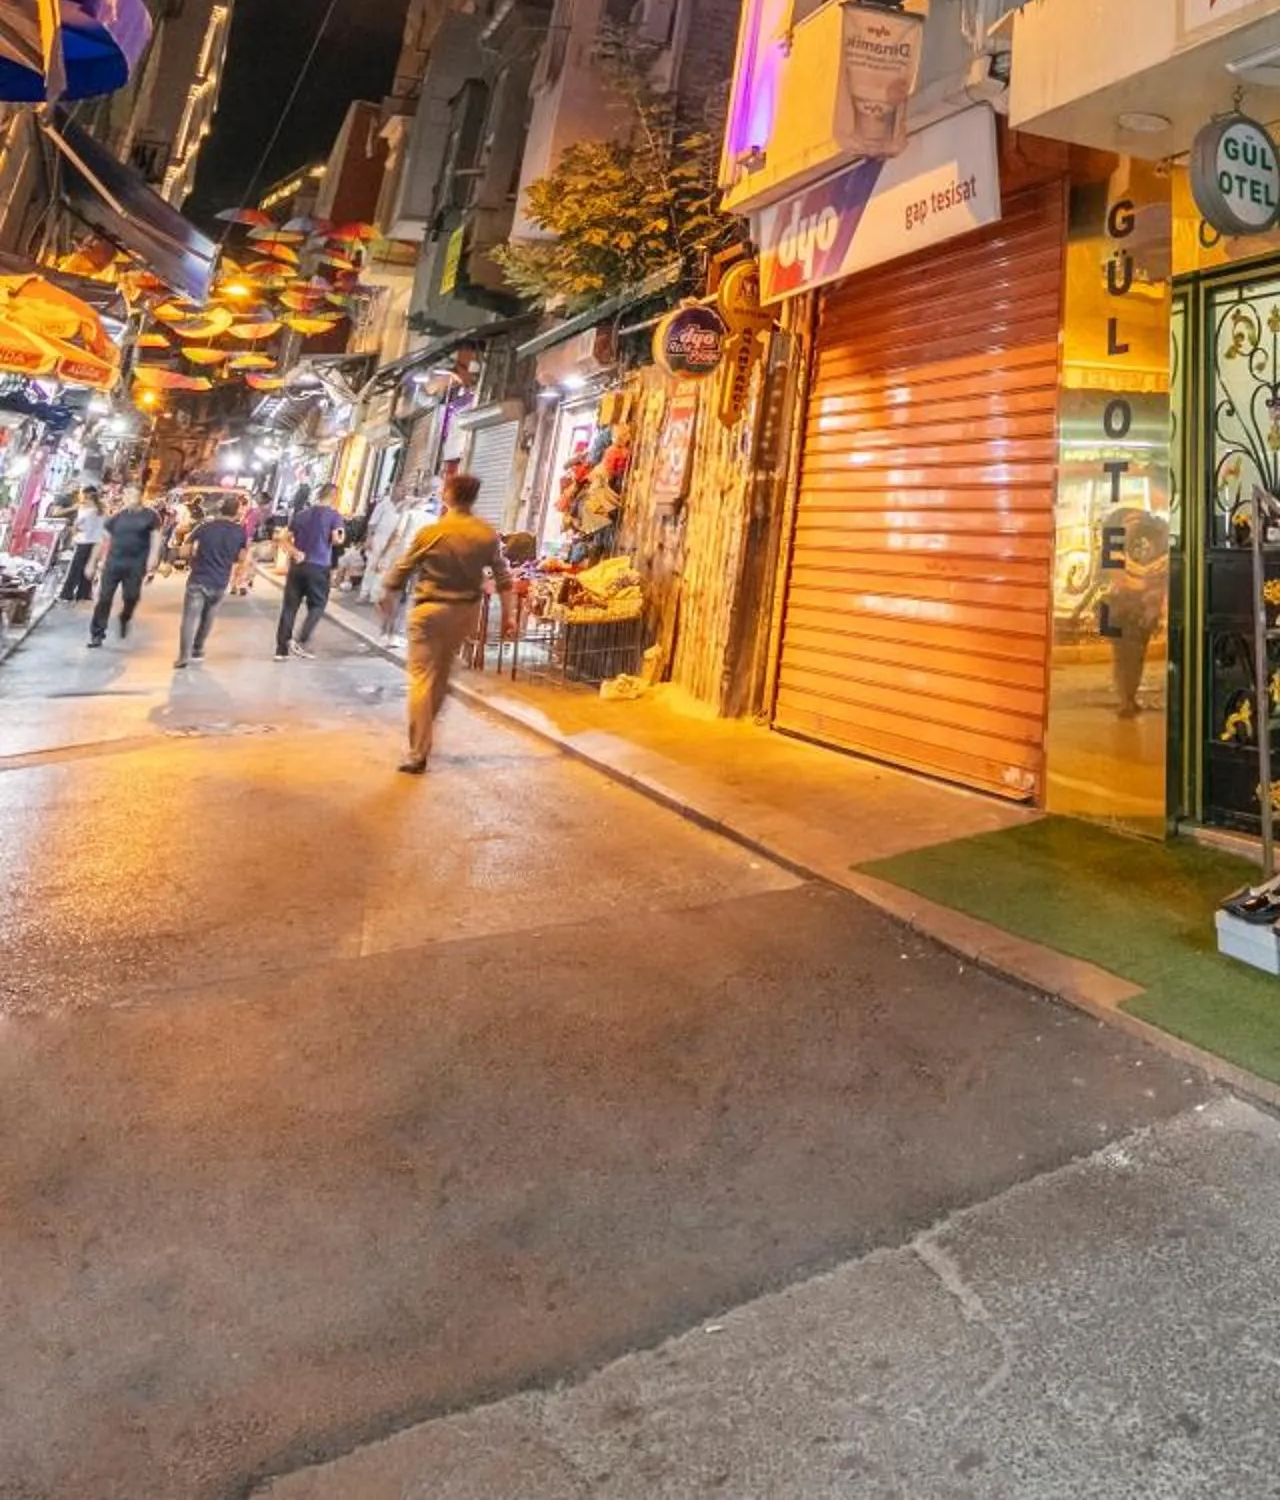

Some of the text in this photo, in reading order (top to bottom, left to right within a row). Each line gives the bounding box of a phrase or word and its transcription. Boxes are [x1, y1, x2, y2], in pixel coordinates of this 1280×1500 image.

[1218, 171, 1275, 207] OTEL
[1223, 134, 1273, 172] GÜL
[777, 173, 977, 280] dyo gap tesisat
[1099, 199, 1135, 638] GÜL OTEL
